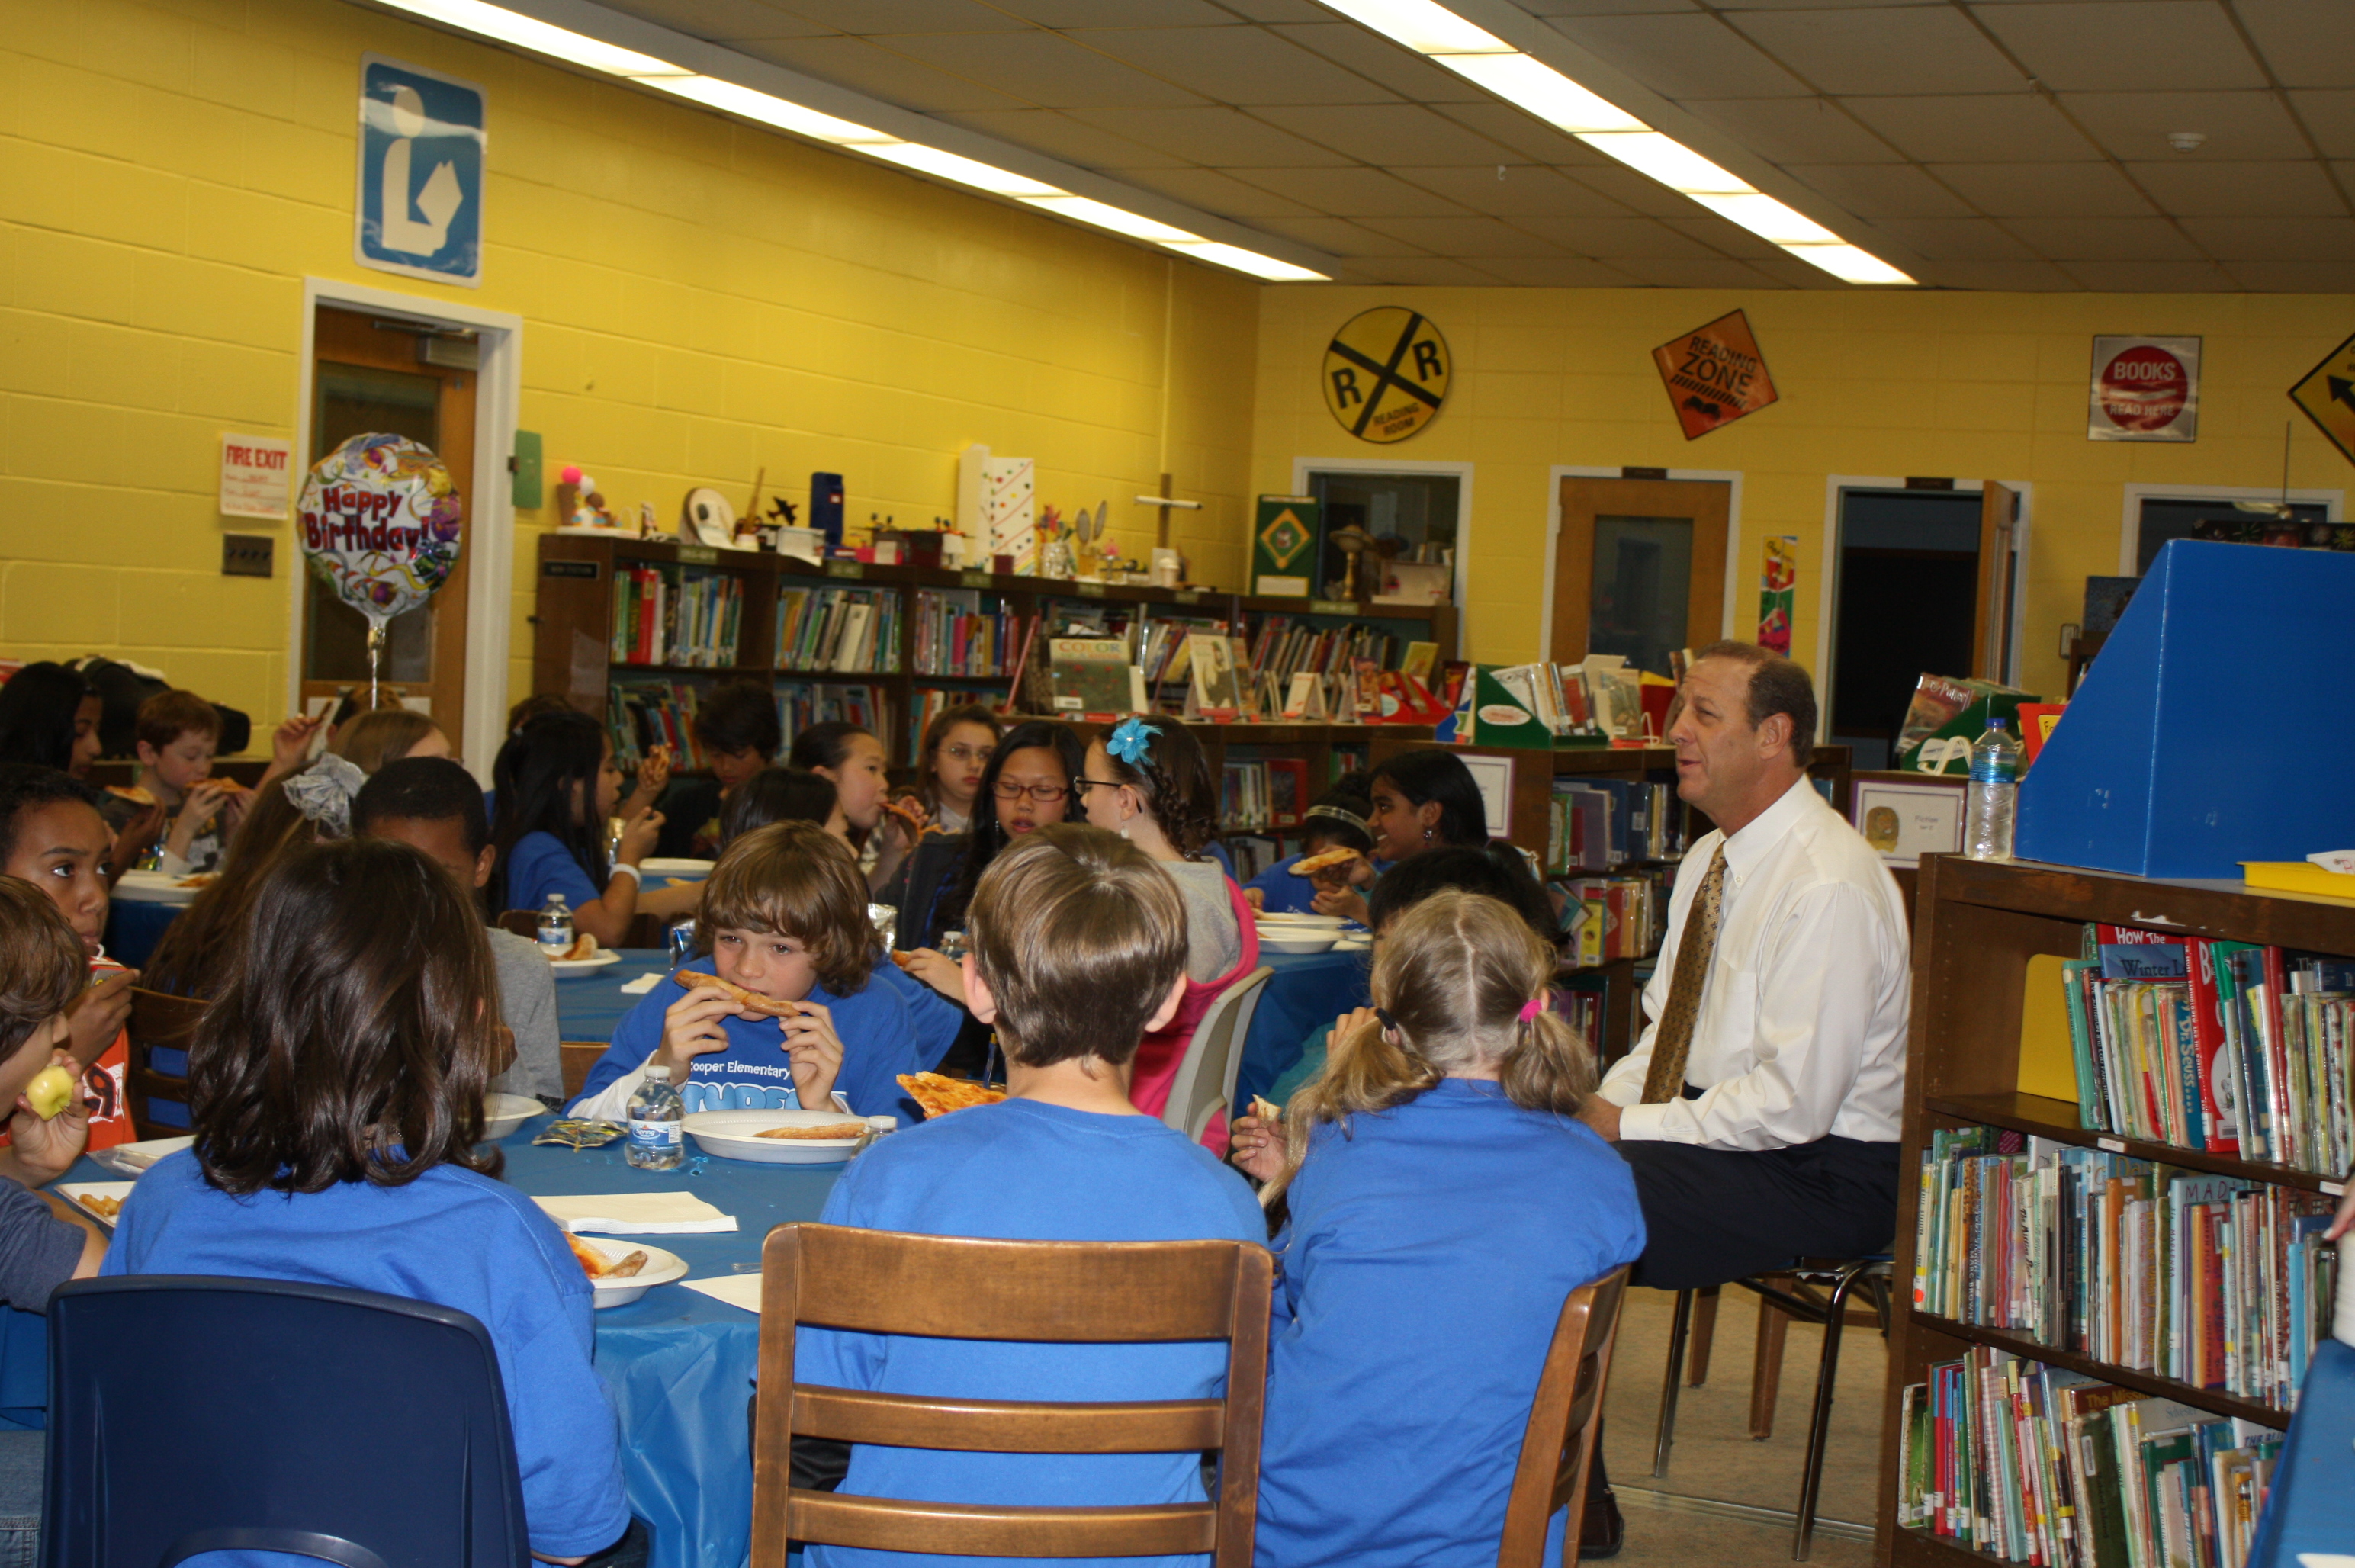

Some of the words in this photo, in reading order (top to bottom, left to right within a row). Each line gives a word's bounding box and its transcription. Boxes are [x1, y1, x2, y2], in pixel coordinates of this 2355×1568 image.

[1412, 339, 1444, 381] R
[1690, 336, 1757, 372] READING
[1679, 354, 1753, 397] ZONE
[2113, 362, 2176, 381] BOOKS
[1331, 367, 1363, 410] R
[1373, 403, 1419, 426] READING
[2109, 403, 2141, 416] READ
[2144, 404, 2174, 416] HERE
[1383, 417, 1415, 436] ROOM
[226, 445, 252, 467] FIRE
[255, 448, 288, 470] EXIT
[322, 487, 403, 522] Happy
[305, 513, 429, 559] Birthday!
[2121, 959, 2169, 976] Winter
[2092, 998, 2100, 1033] JOHNSON
[2187, 981, 2197, 1023] BARTHOLOMEW
[727, 1060, 791, 1081] Elementary
[2086, 1393, 2109, 1408] The
[2159, 1513, 2167, 1545] ROLLING
